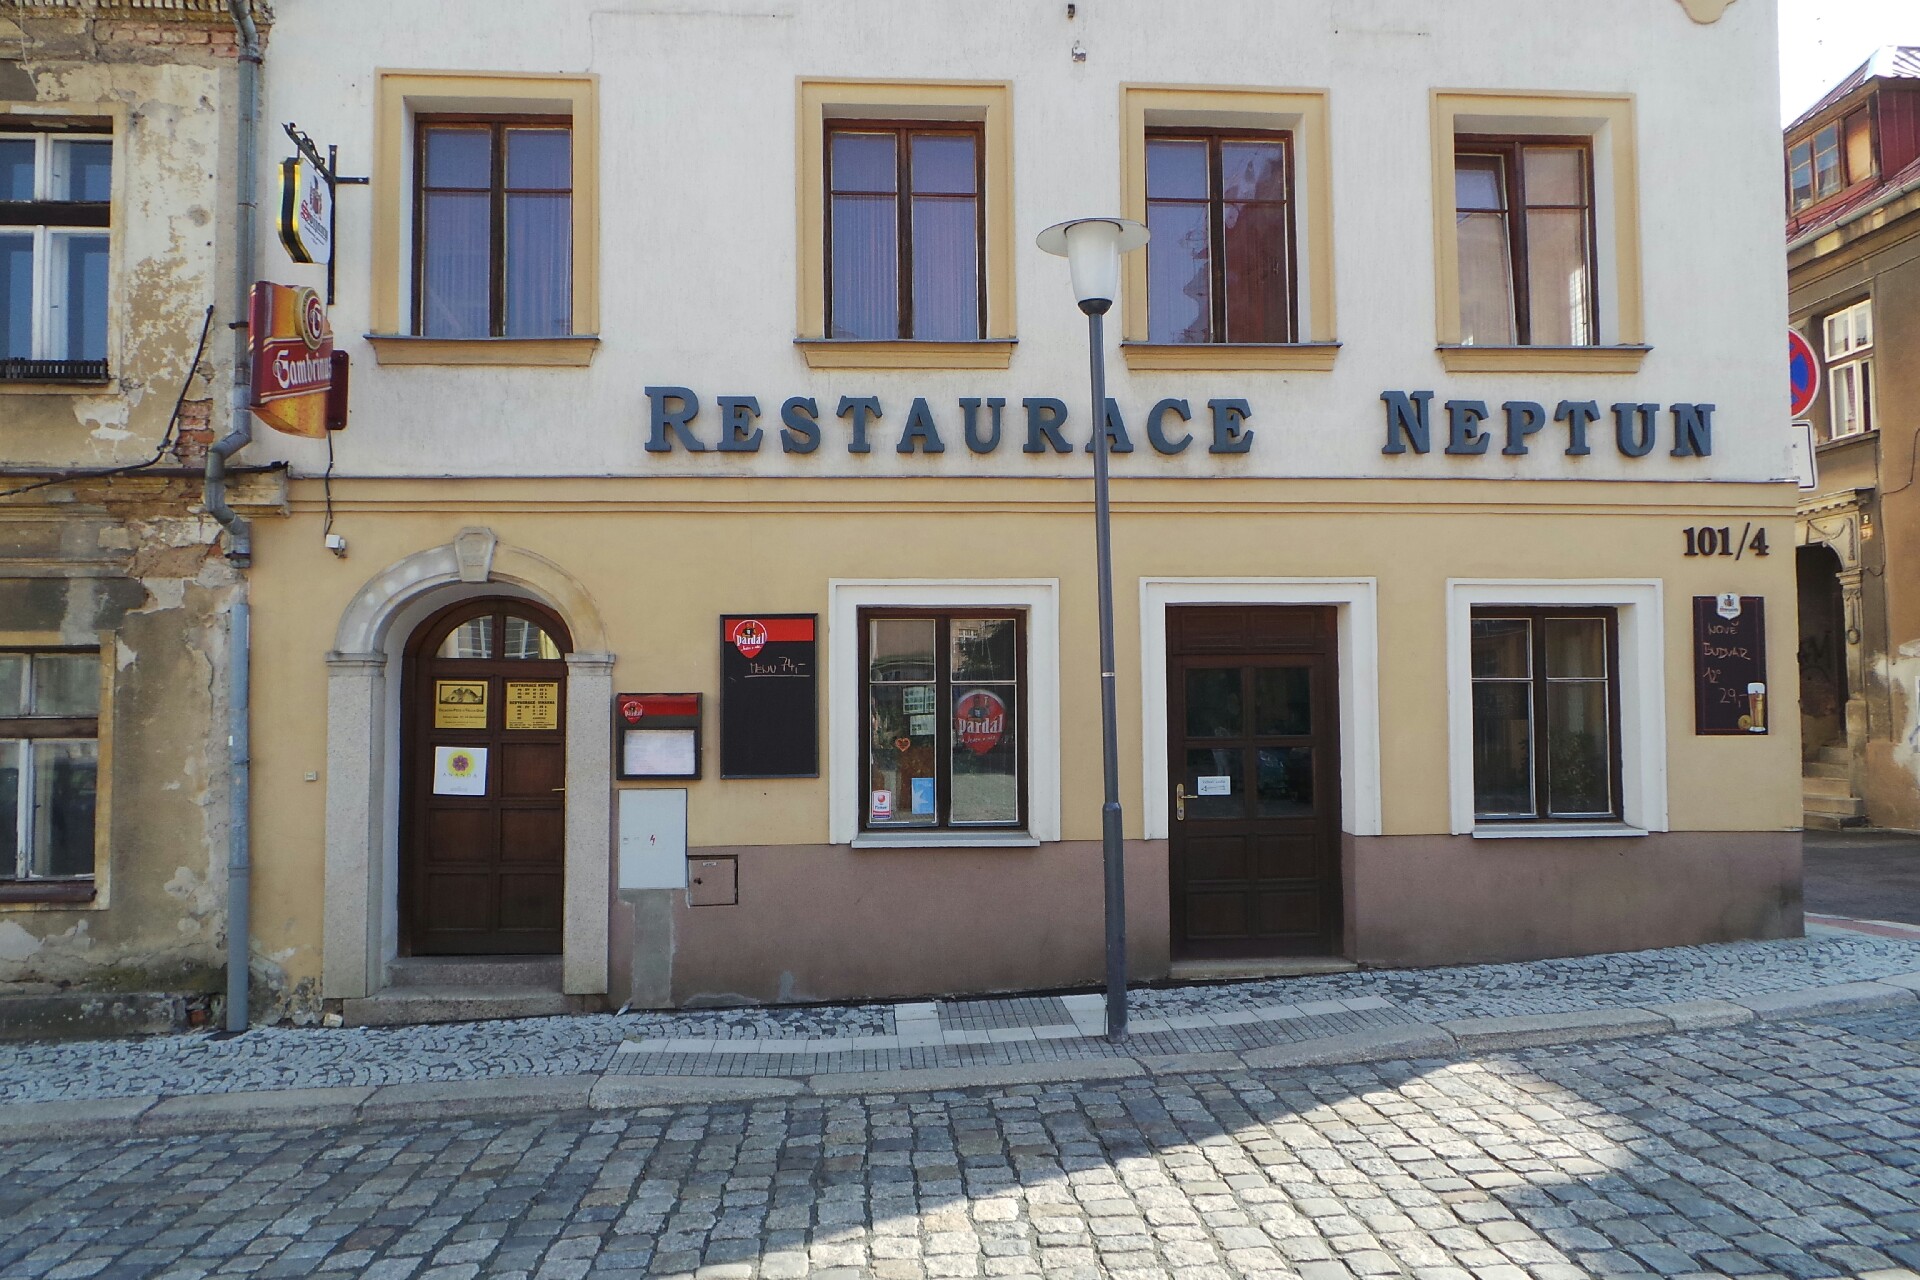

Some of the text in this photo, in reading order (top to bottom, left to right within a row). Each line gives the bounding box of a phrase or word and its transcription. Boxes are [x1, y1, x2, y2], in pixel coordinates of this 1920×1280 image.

[272, 349, 332, 389] Gambrinus
[644, 386, 1717, 458] RESTAURACE NEPTUN
[1683, 521, 1770, 561] 101/4
[1703, 641, 1751, 660] BUDVAR
[750, 662, 777, 674] MENU
[957, 714, 1004, 736] pardál
